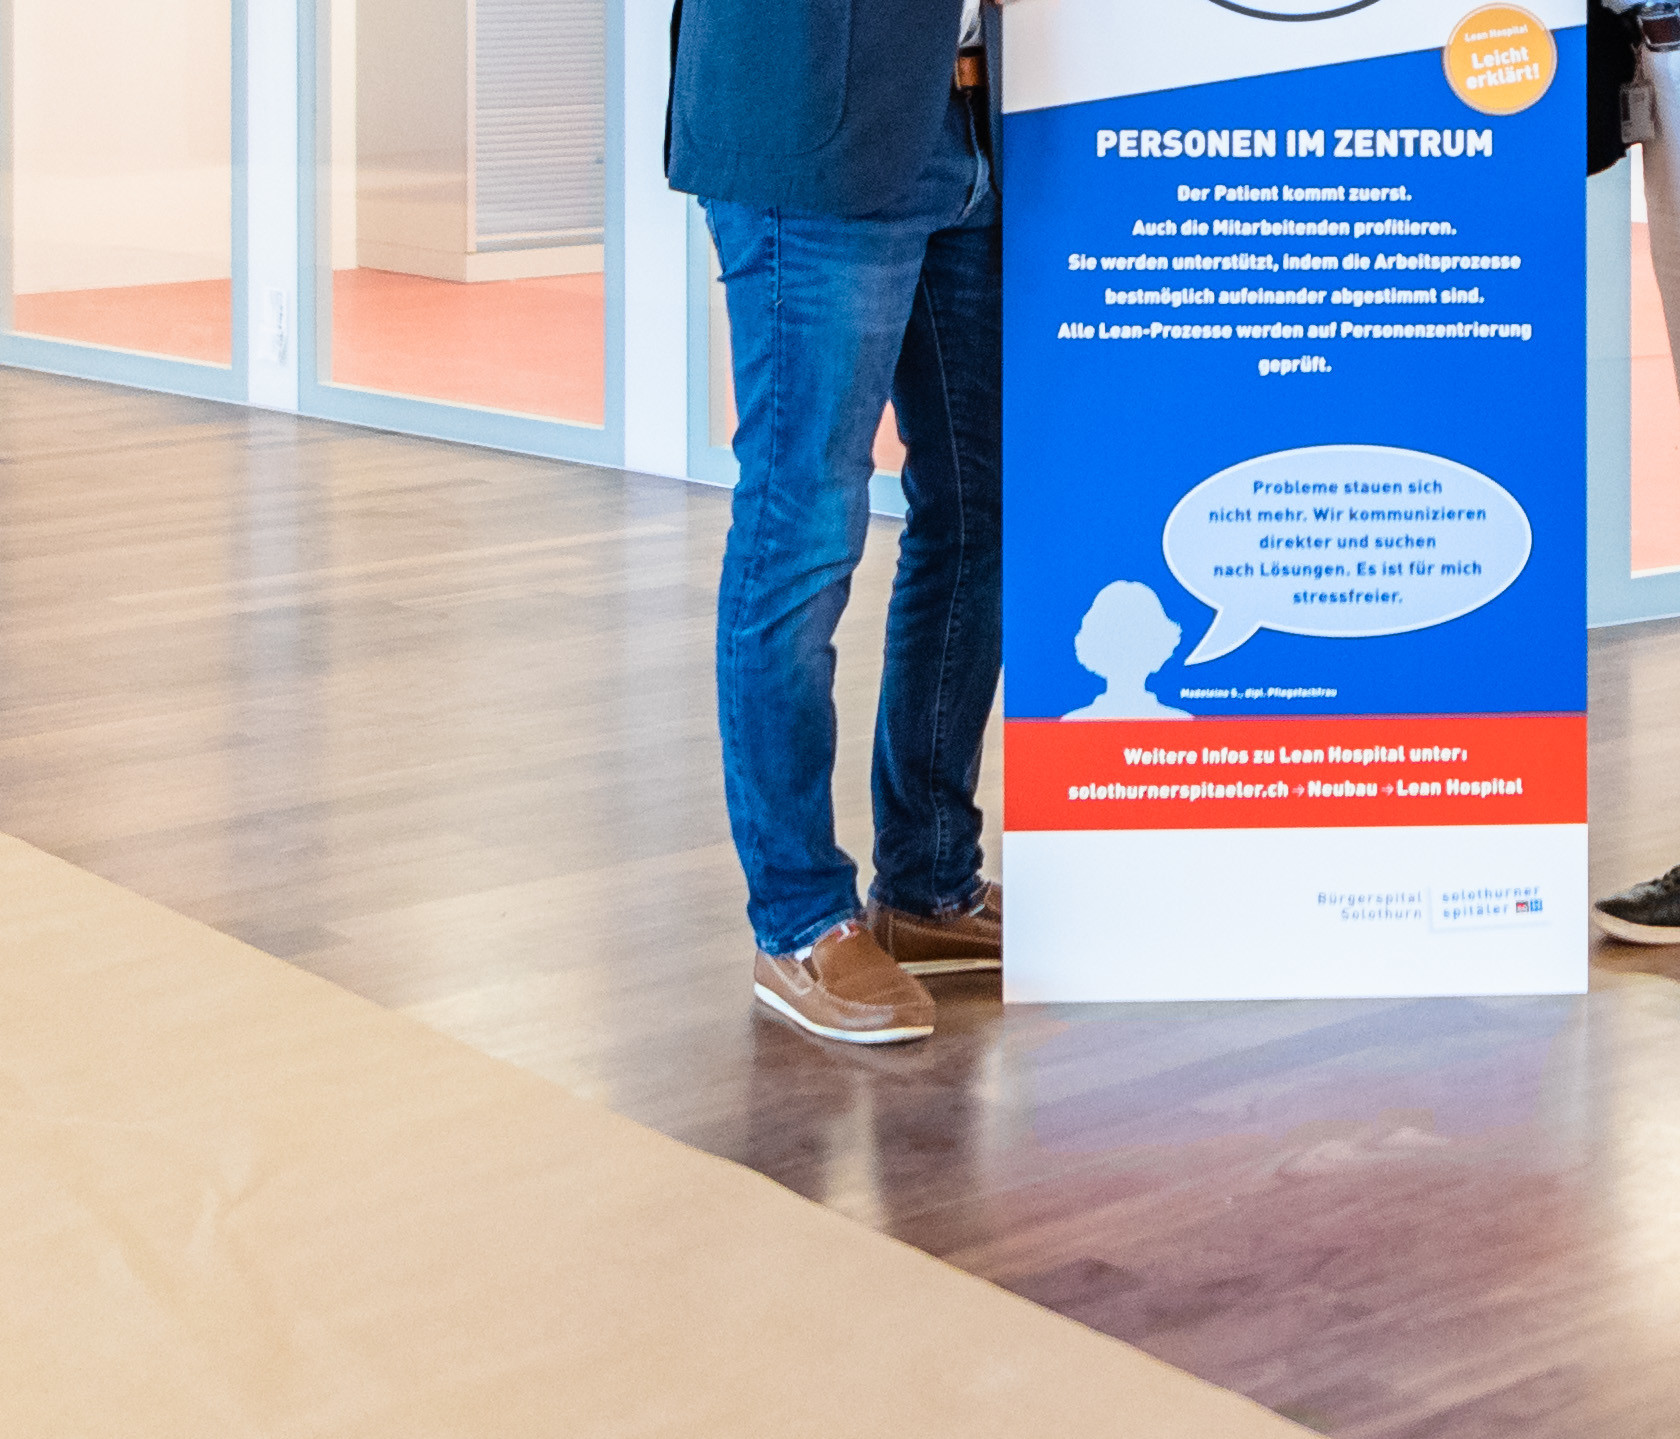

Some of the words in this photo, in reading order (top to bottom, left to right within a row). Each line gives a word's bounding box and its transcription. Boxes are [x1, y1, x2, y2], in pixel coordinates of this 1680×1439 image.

[1464, 32, 1488, 43] Lean
[1489, 24, 1528, 39] Hospital
[1471, 46, 1529, 70] Leicht
[1465, 63, 1540, 90] erklärt!
[1097, 130, 1277, 158] PERSONEN
[1287, 130, 1325, 158] IM
[1334, 129, 1493, 158] ZENTRUM
[1178, 185, 1211, 202] Der
[1214, 185, 1279, 202] Patient
[1283, 185, 1346, 202] kommt
[1349, 186, 1413, 202] zuerst.
[1132, 220, 1178, 237] Auch
[1181, 220, 1210, 236] die
[1213, 219, 1351, 237] Mitarbeitenden
[1354, 219, 1457, 239] profitieren.
[1068, 254, 1098, 271] Sie
[1101, 254, 1169, 271] werden
[1172, 253, 1280, 273] unterstützt,
[1283, 254, 1339, 271] indem
[1342, 253, 1371, 271] die
[1374, 253, 1522, 273] Arbeitsprozesse
[1105, 287, 1216, 308] bestmöglich
[1218, 288, 1328, 305] aufeinander
[1331, 288, 1438, 308] abgestimmt
[1441, 287, 1485, 304] sind.
[1058, 323, 1096, 340] Alle
[1099, 322, 1233, 340] Lean-Prozesse
[1236, 322, 1304, 339] werden
[1307, 322, 1338, 339] auf
[1341, 322, 1533, 341] Personenzentrierung
[1258, 356, 1332, 377] geprüft.
[1253, 480, 1339, 495] Probleme
[1344, 481, 1403, 495] stauen
[1408, 479, 1443, 494] sich
[1209, 508, 1251, 522] nicht
[1257, 508, 1308, 522] mehr.
[1313, 507, 1343, 521] Wir
[1349, 508, 1487, 521] kommunizieren
[1259, 535, 1332, 549] direkter
[1337, 535, 1369, 549] und
[1375, 534, 1436, 548] suchen
[1213, 562, 1254, 577] nach
[1259, 563, 1350, 580] Lösungen.
[1356, 561, 1377, 577] Es
[1382, 562, 1403, 576] ist
[1409, 561, 1433, 576] für
[1440, 561, 1482, 575] mich
[1293, 589, 1403, 604] stressfreier.
[1124, 748, 1198, 766] Weitere
[1202, 747, 1249, 765] Infos
[1254, 750, 1275, 765] zu
[1280, 747, 1325, 764] Lean
[1328, 746, 1406, 766] Hospital
[1410, 746, 1468, 763] unter:
[1069, 781, 1289, 802] solothurnerspitaeler.ch
[1308, 780, 1378, 798] Neubau
[1397, 779, 1442, 797] Lean
[1446, 778, 1523, 799] Hospital
[1317, 890, 1422, 908] Bürgerspital
[1442, 886, 1541, 903] solothurner
[1341, 906, 1422, 921] Solothurn
[1443, 903, 1509, 920] spitäler
